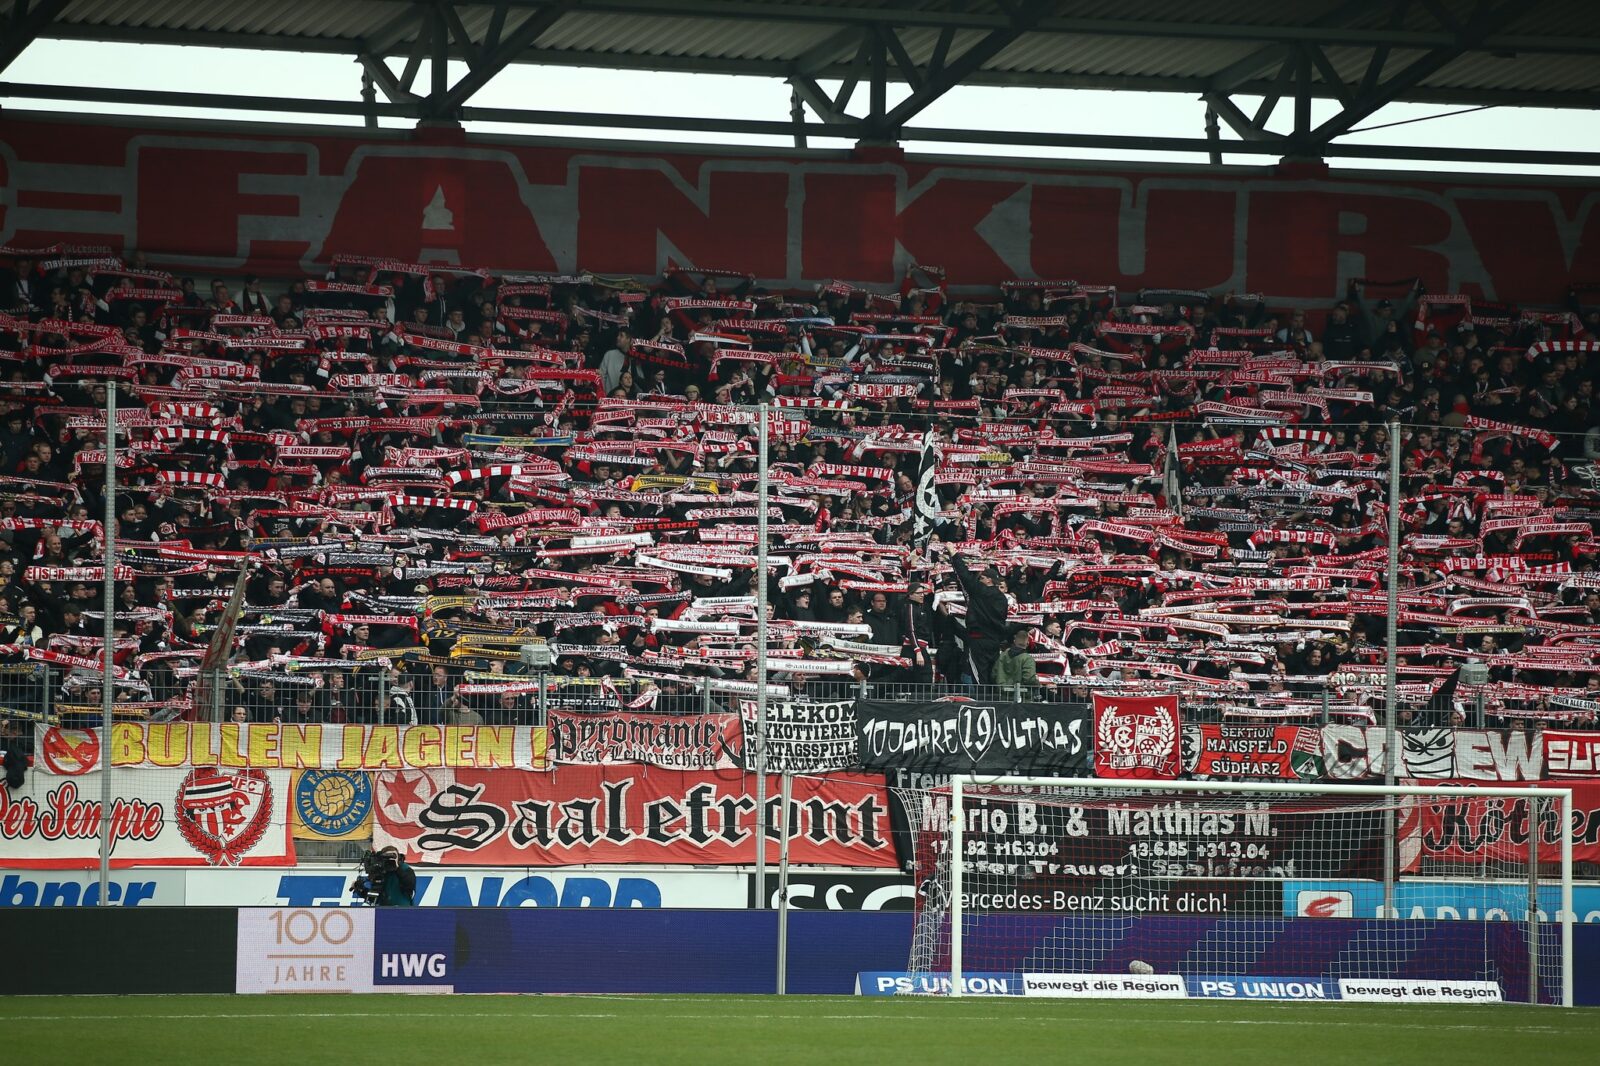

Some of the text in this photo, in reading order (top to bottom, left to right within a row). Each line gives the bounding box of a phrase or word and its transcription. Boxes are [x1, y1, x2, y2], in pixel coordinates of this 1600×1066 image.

[679, 299, 726, 307] HALLESCHER
[720, 319, 785, 333] HALLESCHER FC
[422, 339, 460, 352] HFC CHEMIE
[492, 349, 552, 361] HALLESCHER FC
[725, 351, 750, 359] UNSER
[882, 360, 933, 369] HALLESCHER
[1234, 373, 1266, 382] UNSERE
[1059, 403, 1085, 412] CHEMIE
[1199, 402, 1224, 410] CHEMIE
[1226, 407, 1252, 415] UNSER
[345, 420, 370, 428] JAHRE
[640, 419, 665, 427] UNSER
[82, 454, 97, 462] HFC
[291, 447, 319, 455] UNSER
[419, 449, 445, 457] UNSER
[597, 455, 651, 465] UNBREAKABLE
[944, 468, 1006, 476] HFC CHEMIE
[486, 512, 532, 530] HALLESCHER
[657, 521, 699, 529] CHEMIE
[1100, 522, 1127, 534] UNSER
[1501, 518, 1525, 526] UNSER
[1266, 531, 1297, 540] MEIN
[28, 566, 76, 580] EISERN
[1313, 569, 1339, 577] UNSER
[1236, 576, 1330, 590] EISERN CHEMIE
[344, 615, 395, 623] HALLESCHER
[1199, 614, 1225, 622] HALLESCHER
[55, 654, 100, 668] HFC CHEMIE
[1570, 699, 1582, 707] ALLE
[742, 701, 857, 724] TELEKOM
[1143, 718, 1157, 726] FC
[964, 709, 991, 754] 19
[996, 717, 1082, 754] ULTRAS
[1138, 726, 1161, 735] RWE
[1220, 728, 1274, 738] SEKTION
[111, 722, 322, 768] BULLEN
[337, 724, 515, 768] JAGEN
[552, 715, 715, 761] Pyromanie
[746, 741, 859, 757] MNTAGSSPIELE
[1207, 738, 1287, 753] MANSFELD
[581, 745, 715, 768] ist Leidenschaft
[1212, 756, 1280, 775] SÜDHARZ
[302, 792, 365, 829] LOKOMOTIVE
[416, 781, 886, 851] Saalefront
[40, 780, 163, 857] Sempre
[1018, 802, 1047, 834] B.
[1067, 804, 1089, 836] &
[1108, 801, 1278, 837] Matthias M.
[1129, 842, 1187, 857] 13.6.85
[945, 890, 1227, 913] ercedes-Benz sucht dich!
[269, 910, 353, 945] 100
[381, 953, 445, 977] HWG
[274, 966, 345, 981] JAHRE
[877, 977, 1008, 993] PS UNION
[1027, 979, 1179, 994] bewegt die Region
[1201, 981, 1324, 997] PS UNION
[1346, 985, 1497, 1000] bewegt die Region
